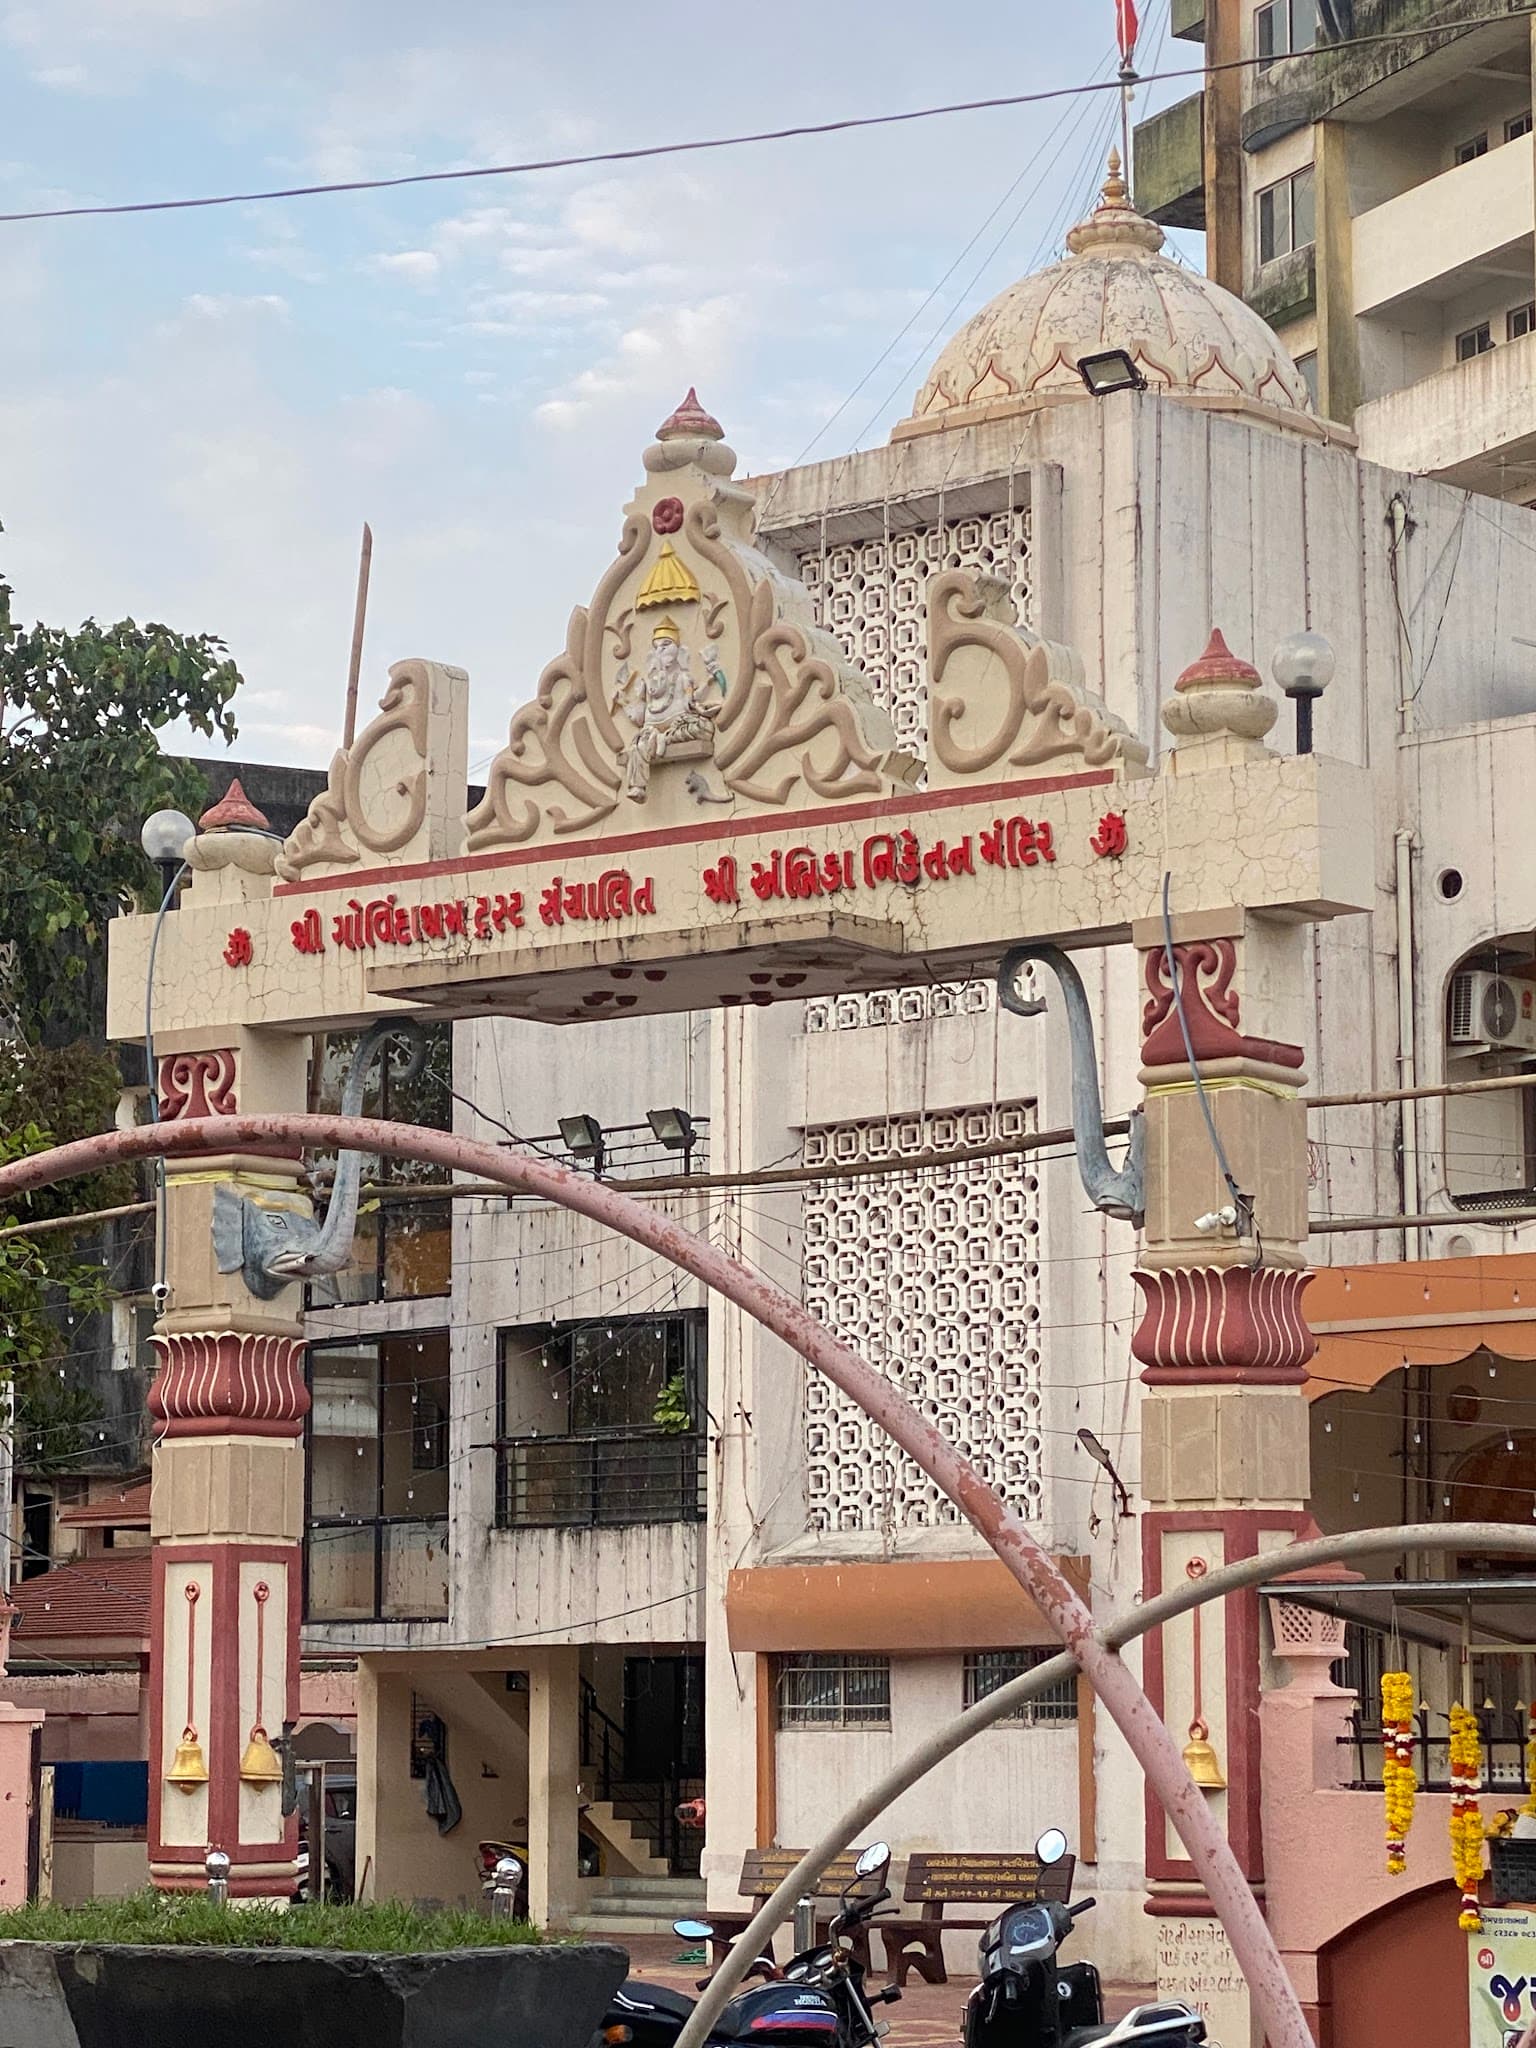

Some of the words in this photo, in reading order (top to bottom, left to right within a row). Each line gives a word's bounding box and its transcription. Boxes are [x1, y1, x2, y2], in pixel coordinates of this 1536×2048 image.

[290, 907, 325, 953] શ્રી
[538, 870, 656, 926] સંચાલિત
[702, 855, 741, 904] શ્રી
[750, 847, 857, 900] અંબિકા
[862, 829, 977, 888] નિકેતન
[979, 815, 1057, 869] મંદિર
